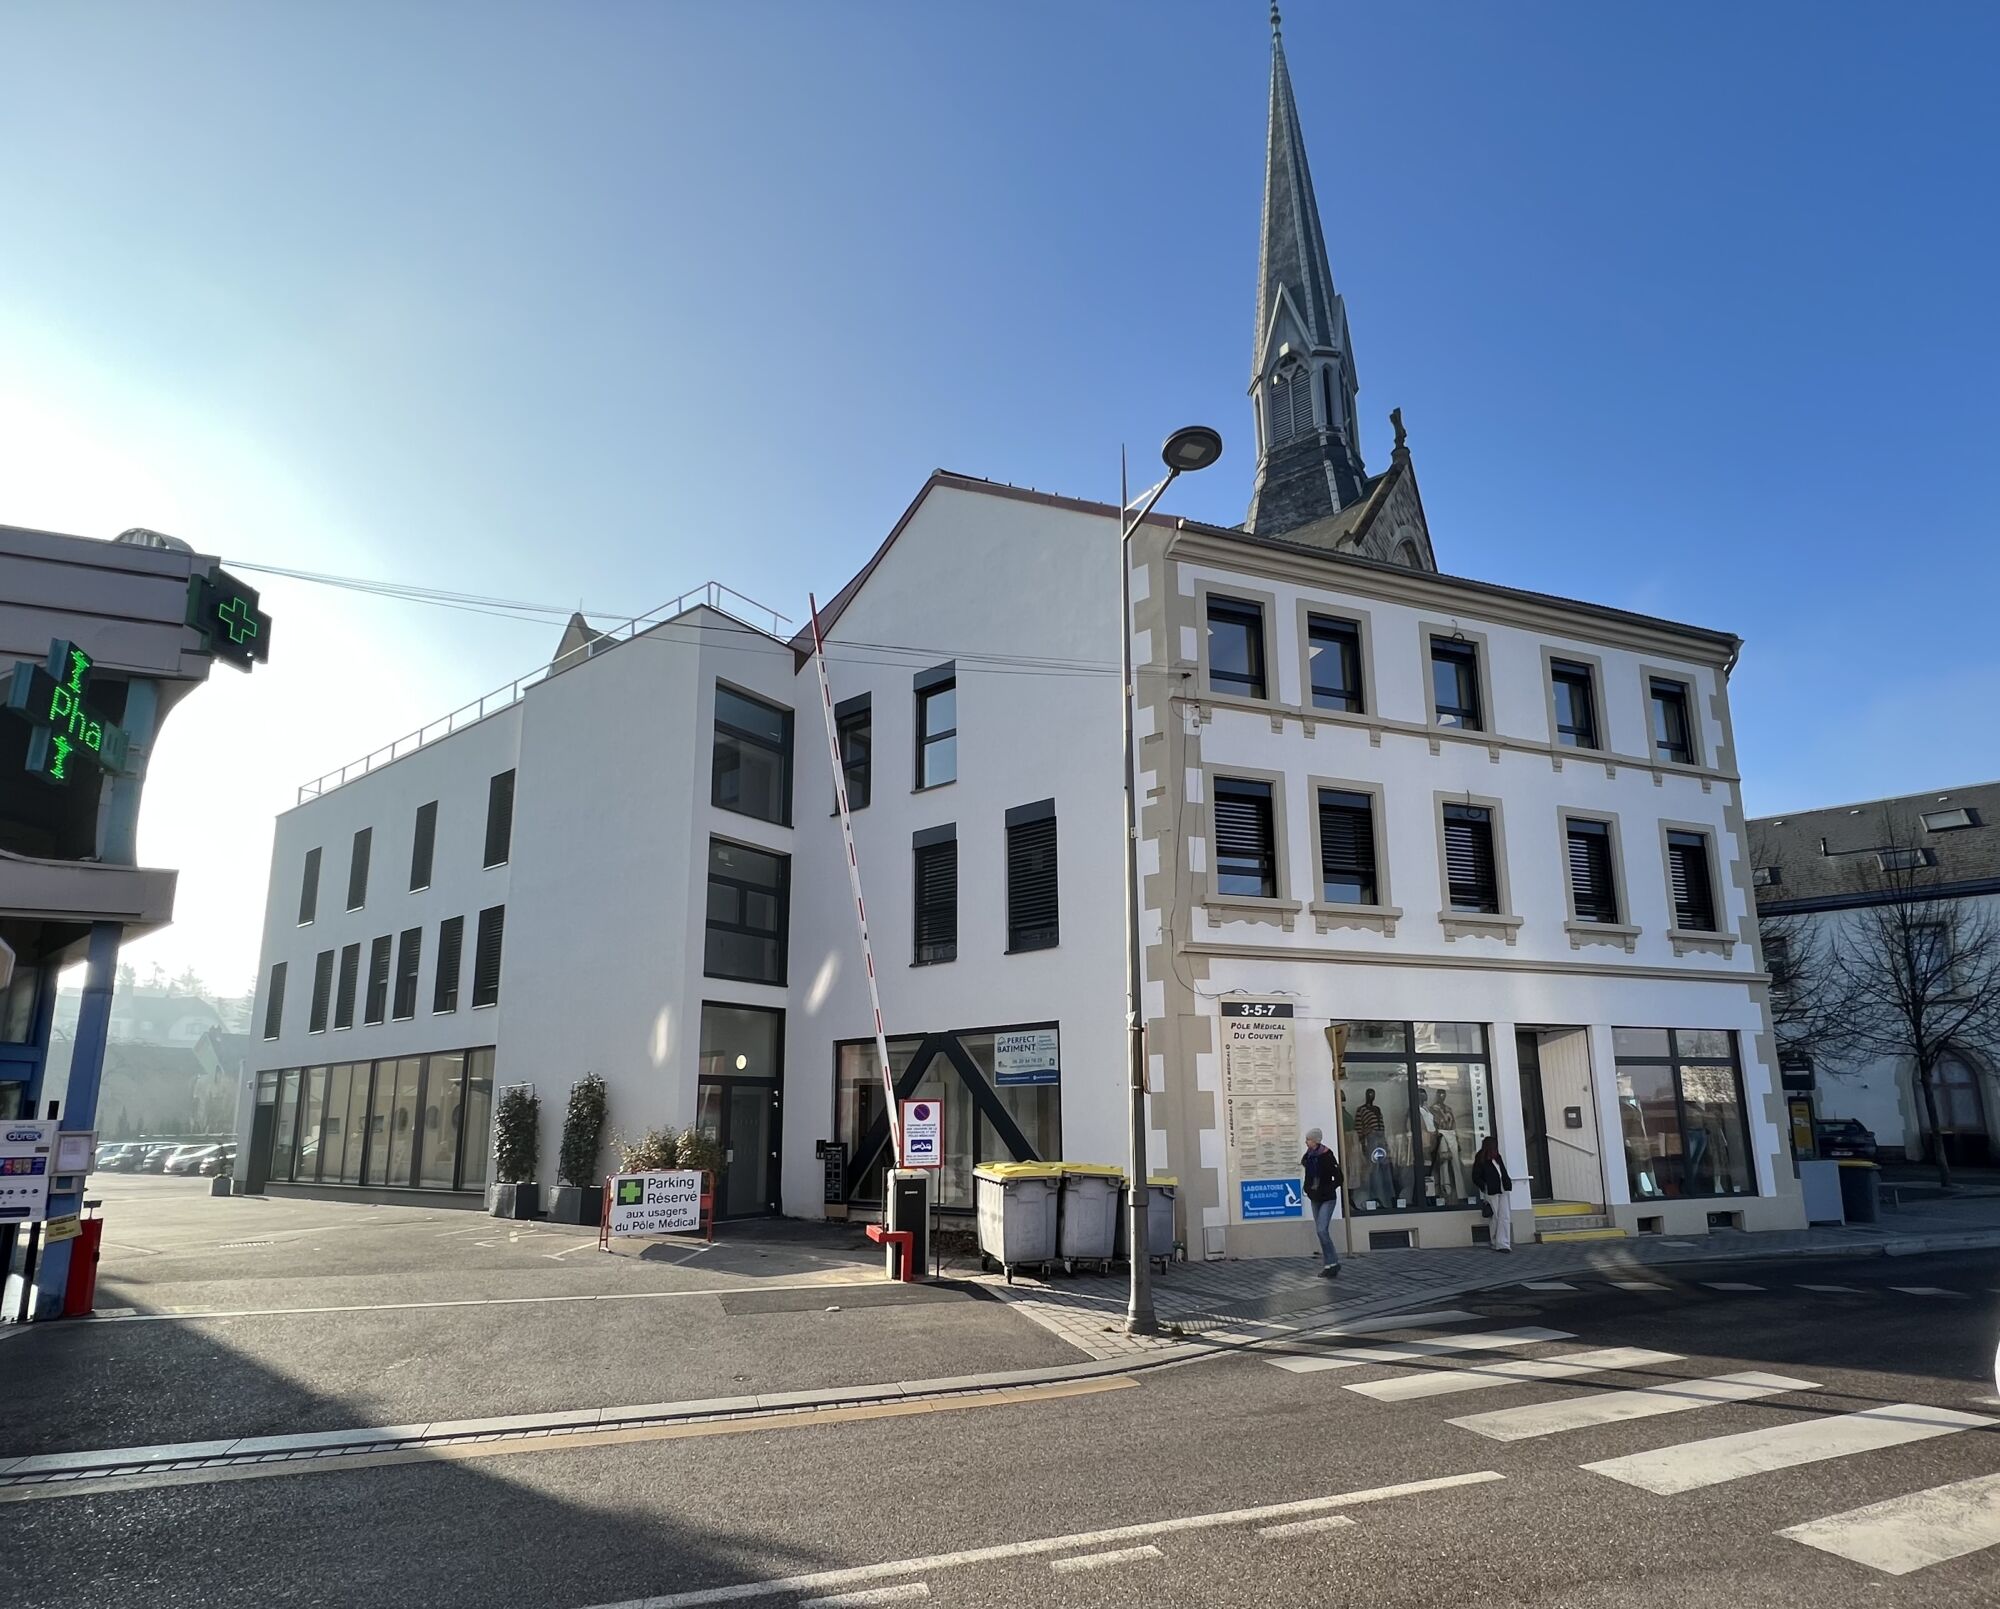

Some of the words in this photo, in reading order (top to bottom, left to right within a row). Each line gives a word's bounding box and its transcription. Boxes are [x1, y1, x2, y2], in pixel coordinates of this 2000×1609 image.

[1241, 1004, 1276, 1016] 3-5-7
[1007, 1035, 1036, 1044] PERFECT
[1247, 1032, 1284, 1040] COUVENT
[997, 1043, 1036, 1053] BATIMENT
[8, 1131, 40, 1141] durex
[648, 1177, 694, 1189] Parking
[1243, 1184, 1284, 1192] LABORATOIRE
[647, 1191, 697, 1204] Réservé
[626, 1211, 644, 1219] aux
[648, 1207, 688, 1218] usagers
[615, 1222, 629, 1232] du
[632, 1220, 655, 1230] Pôle
[658, 1217, 697, 1228] Médical
